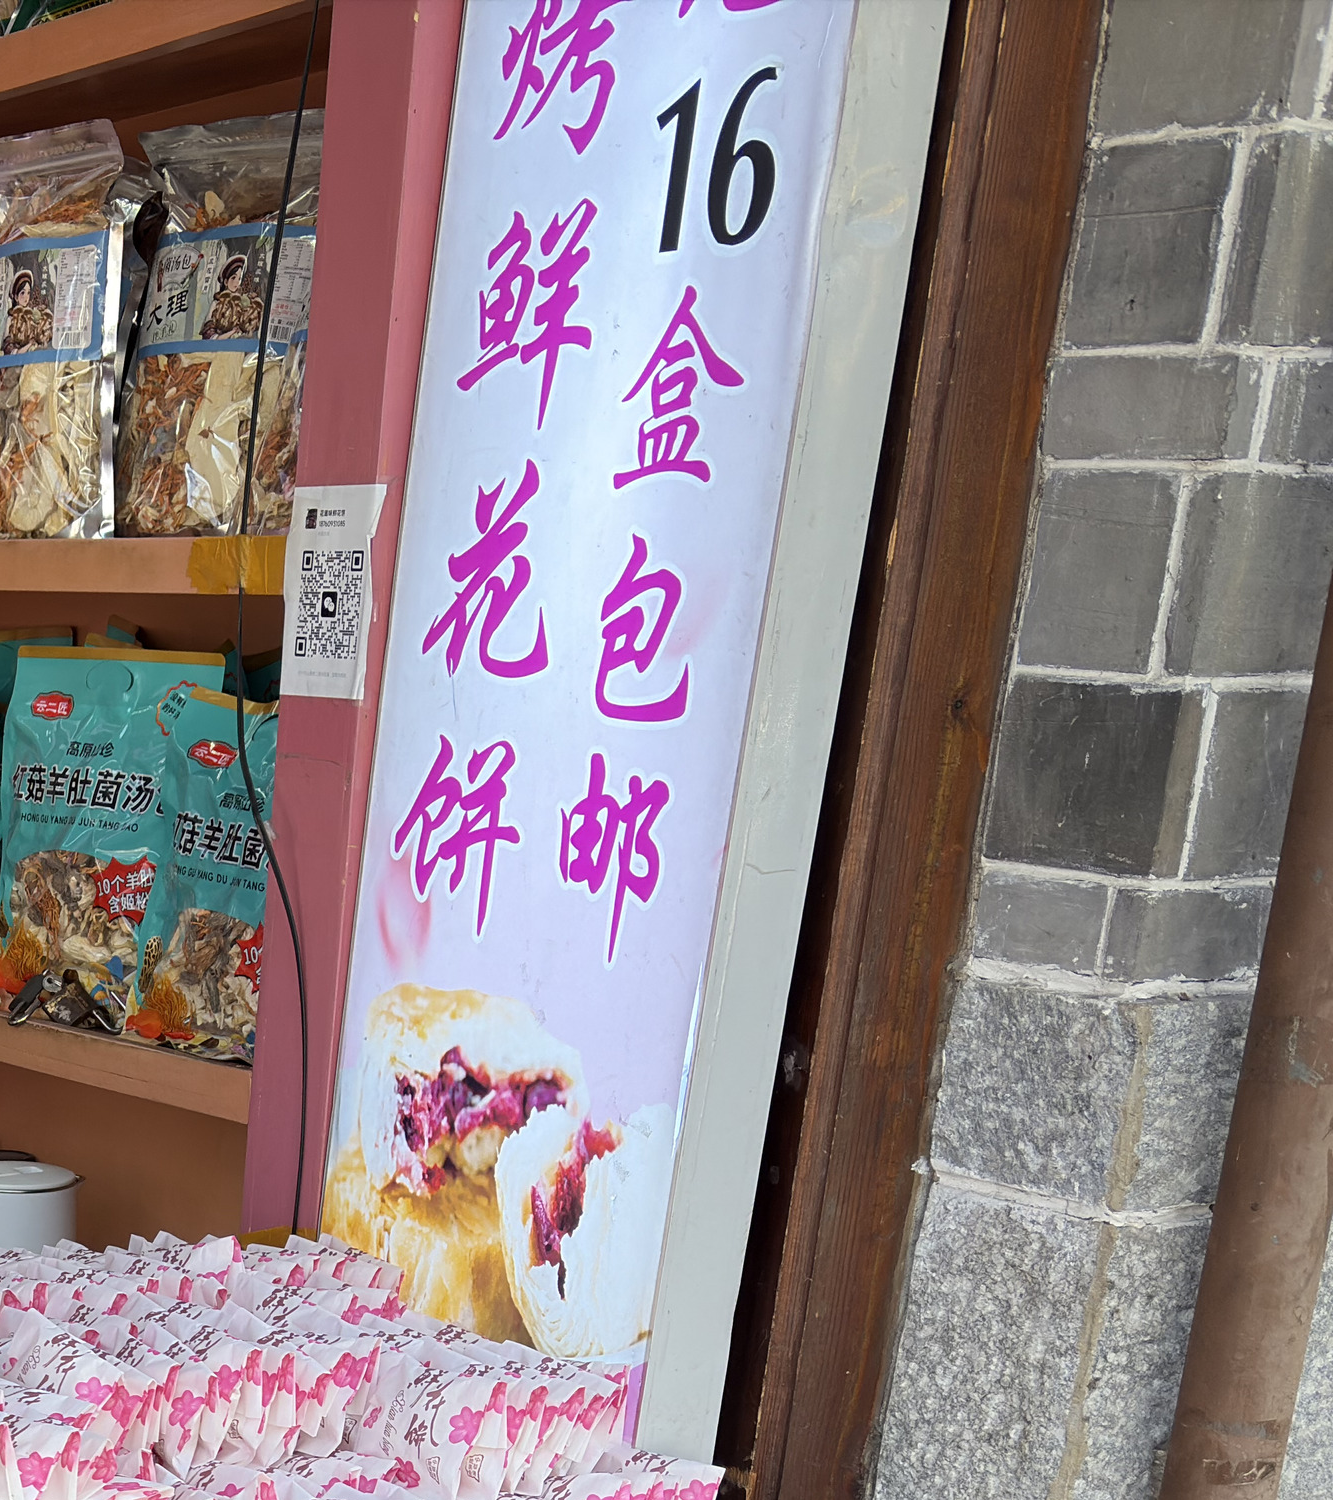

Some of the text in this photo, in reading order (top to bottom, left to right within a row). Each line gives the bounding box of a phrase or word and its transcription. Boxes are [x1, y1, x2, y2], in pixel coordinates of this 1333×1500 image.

[145, 289, 190, 331] 大理
[395, 0, 619, 941] 烤鲜花饼
[36, 701, 70, 716] 云二匠
[66, 740, 115, 758] 高原山珍
[172, 812, 269, 871] 菇羊肚菌
[243, 877, 266, 893] TANG
